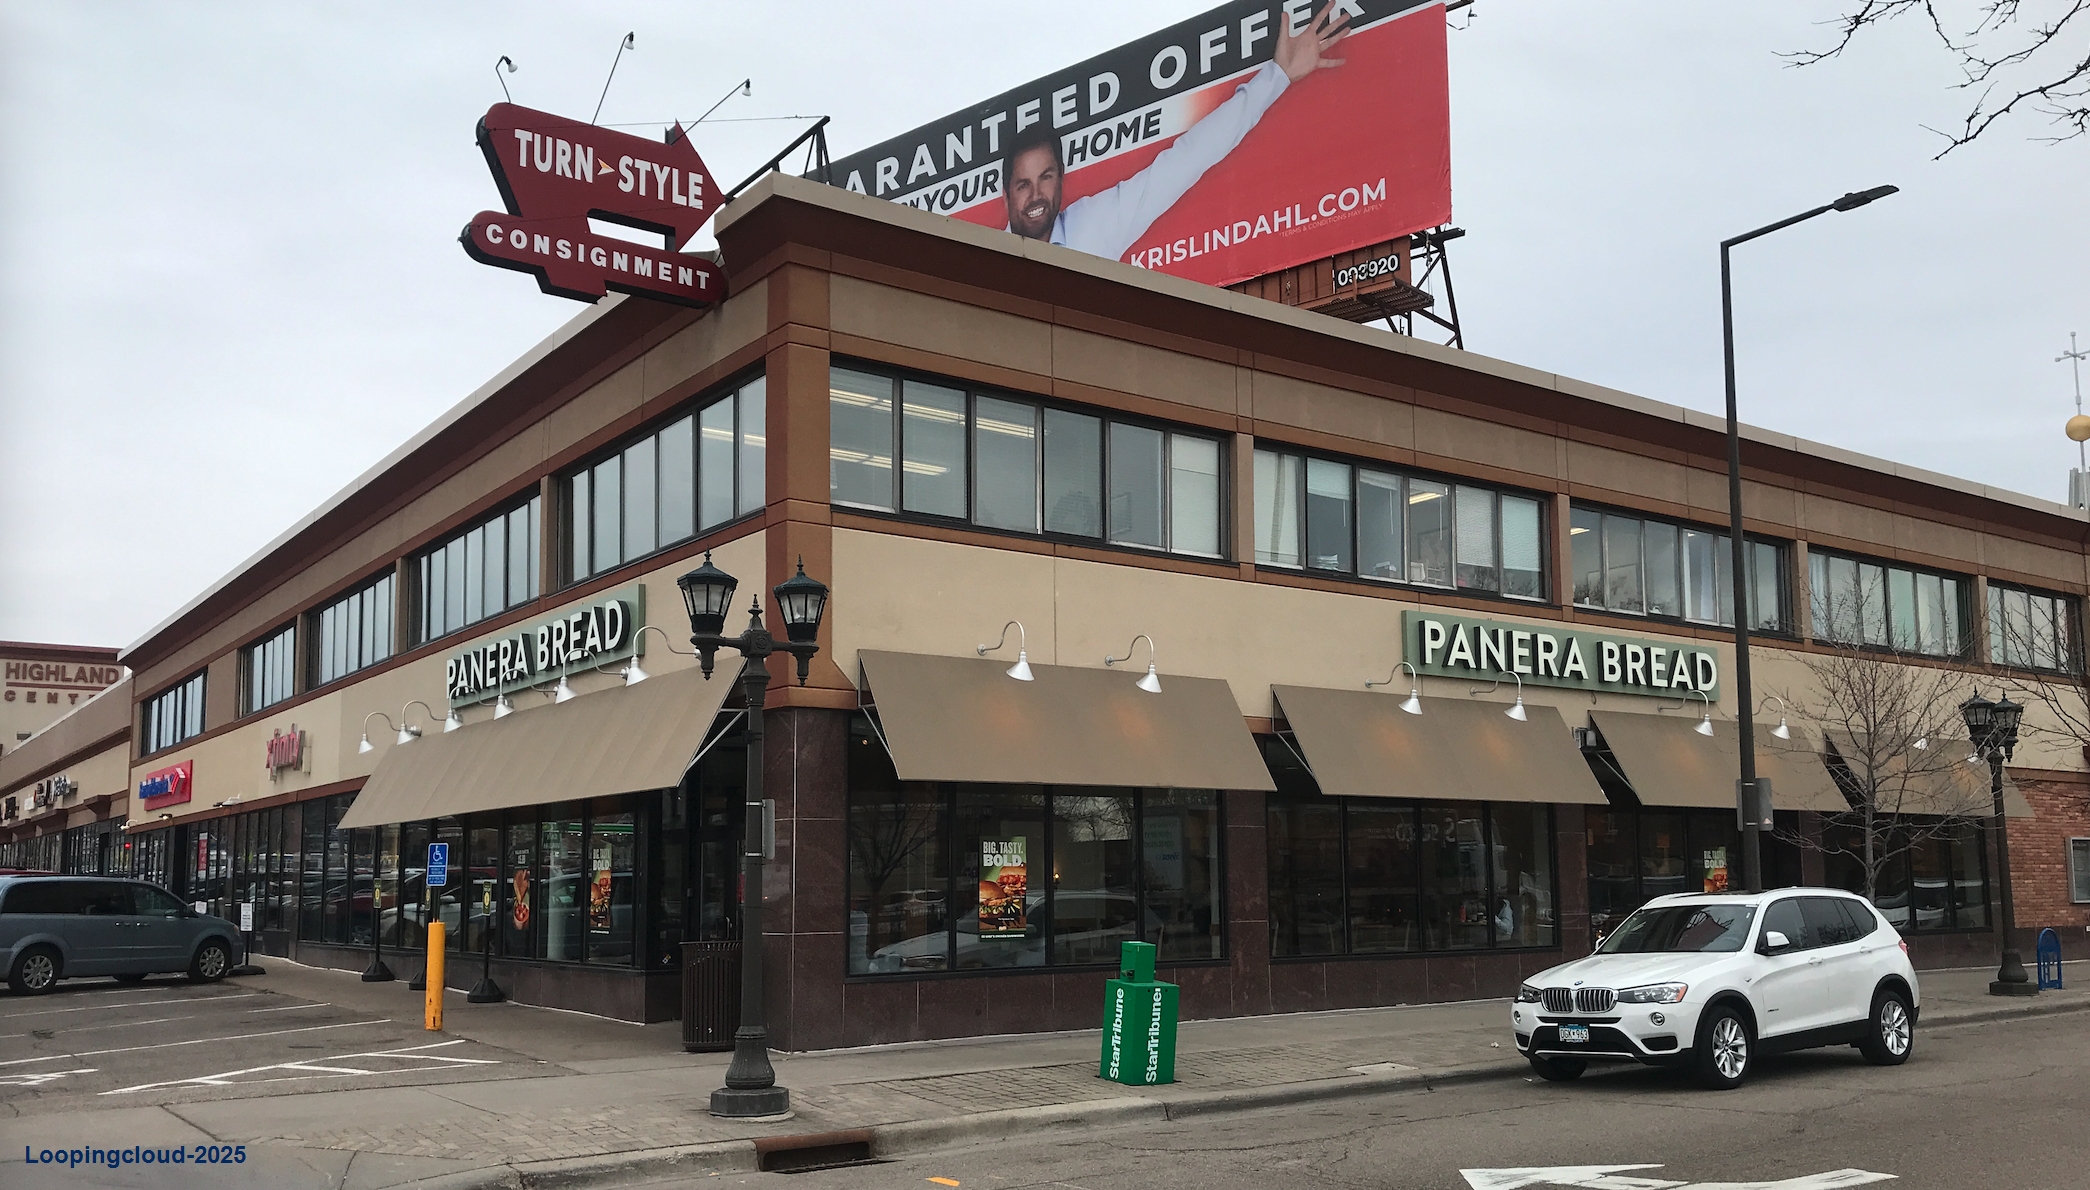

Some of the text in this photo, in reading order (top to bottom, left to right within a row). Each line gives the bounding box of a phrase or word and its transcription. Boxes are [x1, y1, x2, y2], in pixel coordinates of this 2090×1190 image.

[514, 128, 704, 210] TURN STYLE
[923, 168, 1000, 212] YOUR
[1067, 107, 1163, 167] HOME
[1130, 177, 1387, 270] KRISLINDAHL.COM
[1308, 213, 1347, 230] CONDITIONS
[1347, 209, 1361, 219] MAY
[485, 223, 710, 290] CONSIGNMENT
[5, 661, 120, 685] HIGHLAND
[446, 599, 630, 700] PANERA BREAD
[1418, 618, 1718, 692] PANERA BREAD
[4, 689, 96, 706] CENT
[982, 841, 1024, 854] BIG. TASTY.
[982, 854, 1024, 867] BOLD.
[1109, 987, 1125, 1080] StarTribune
